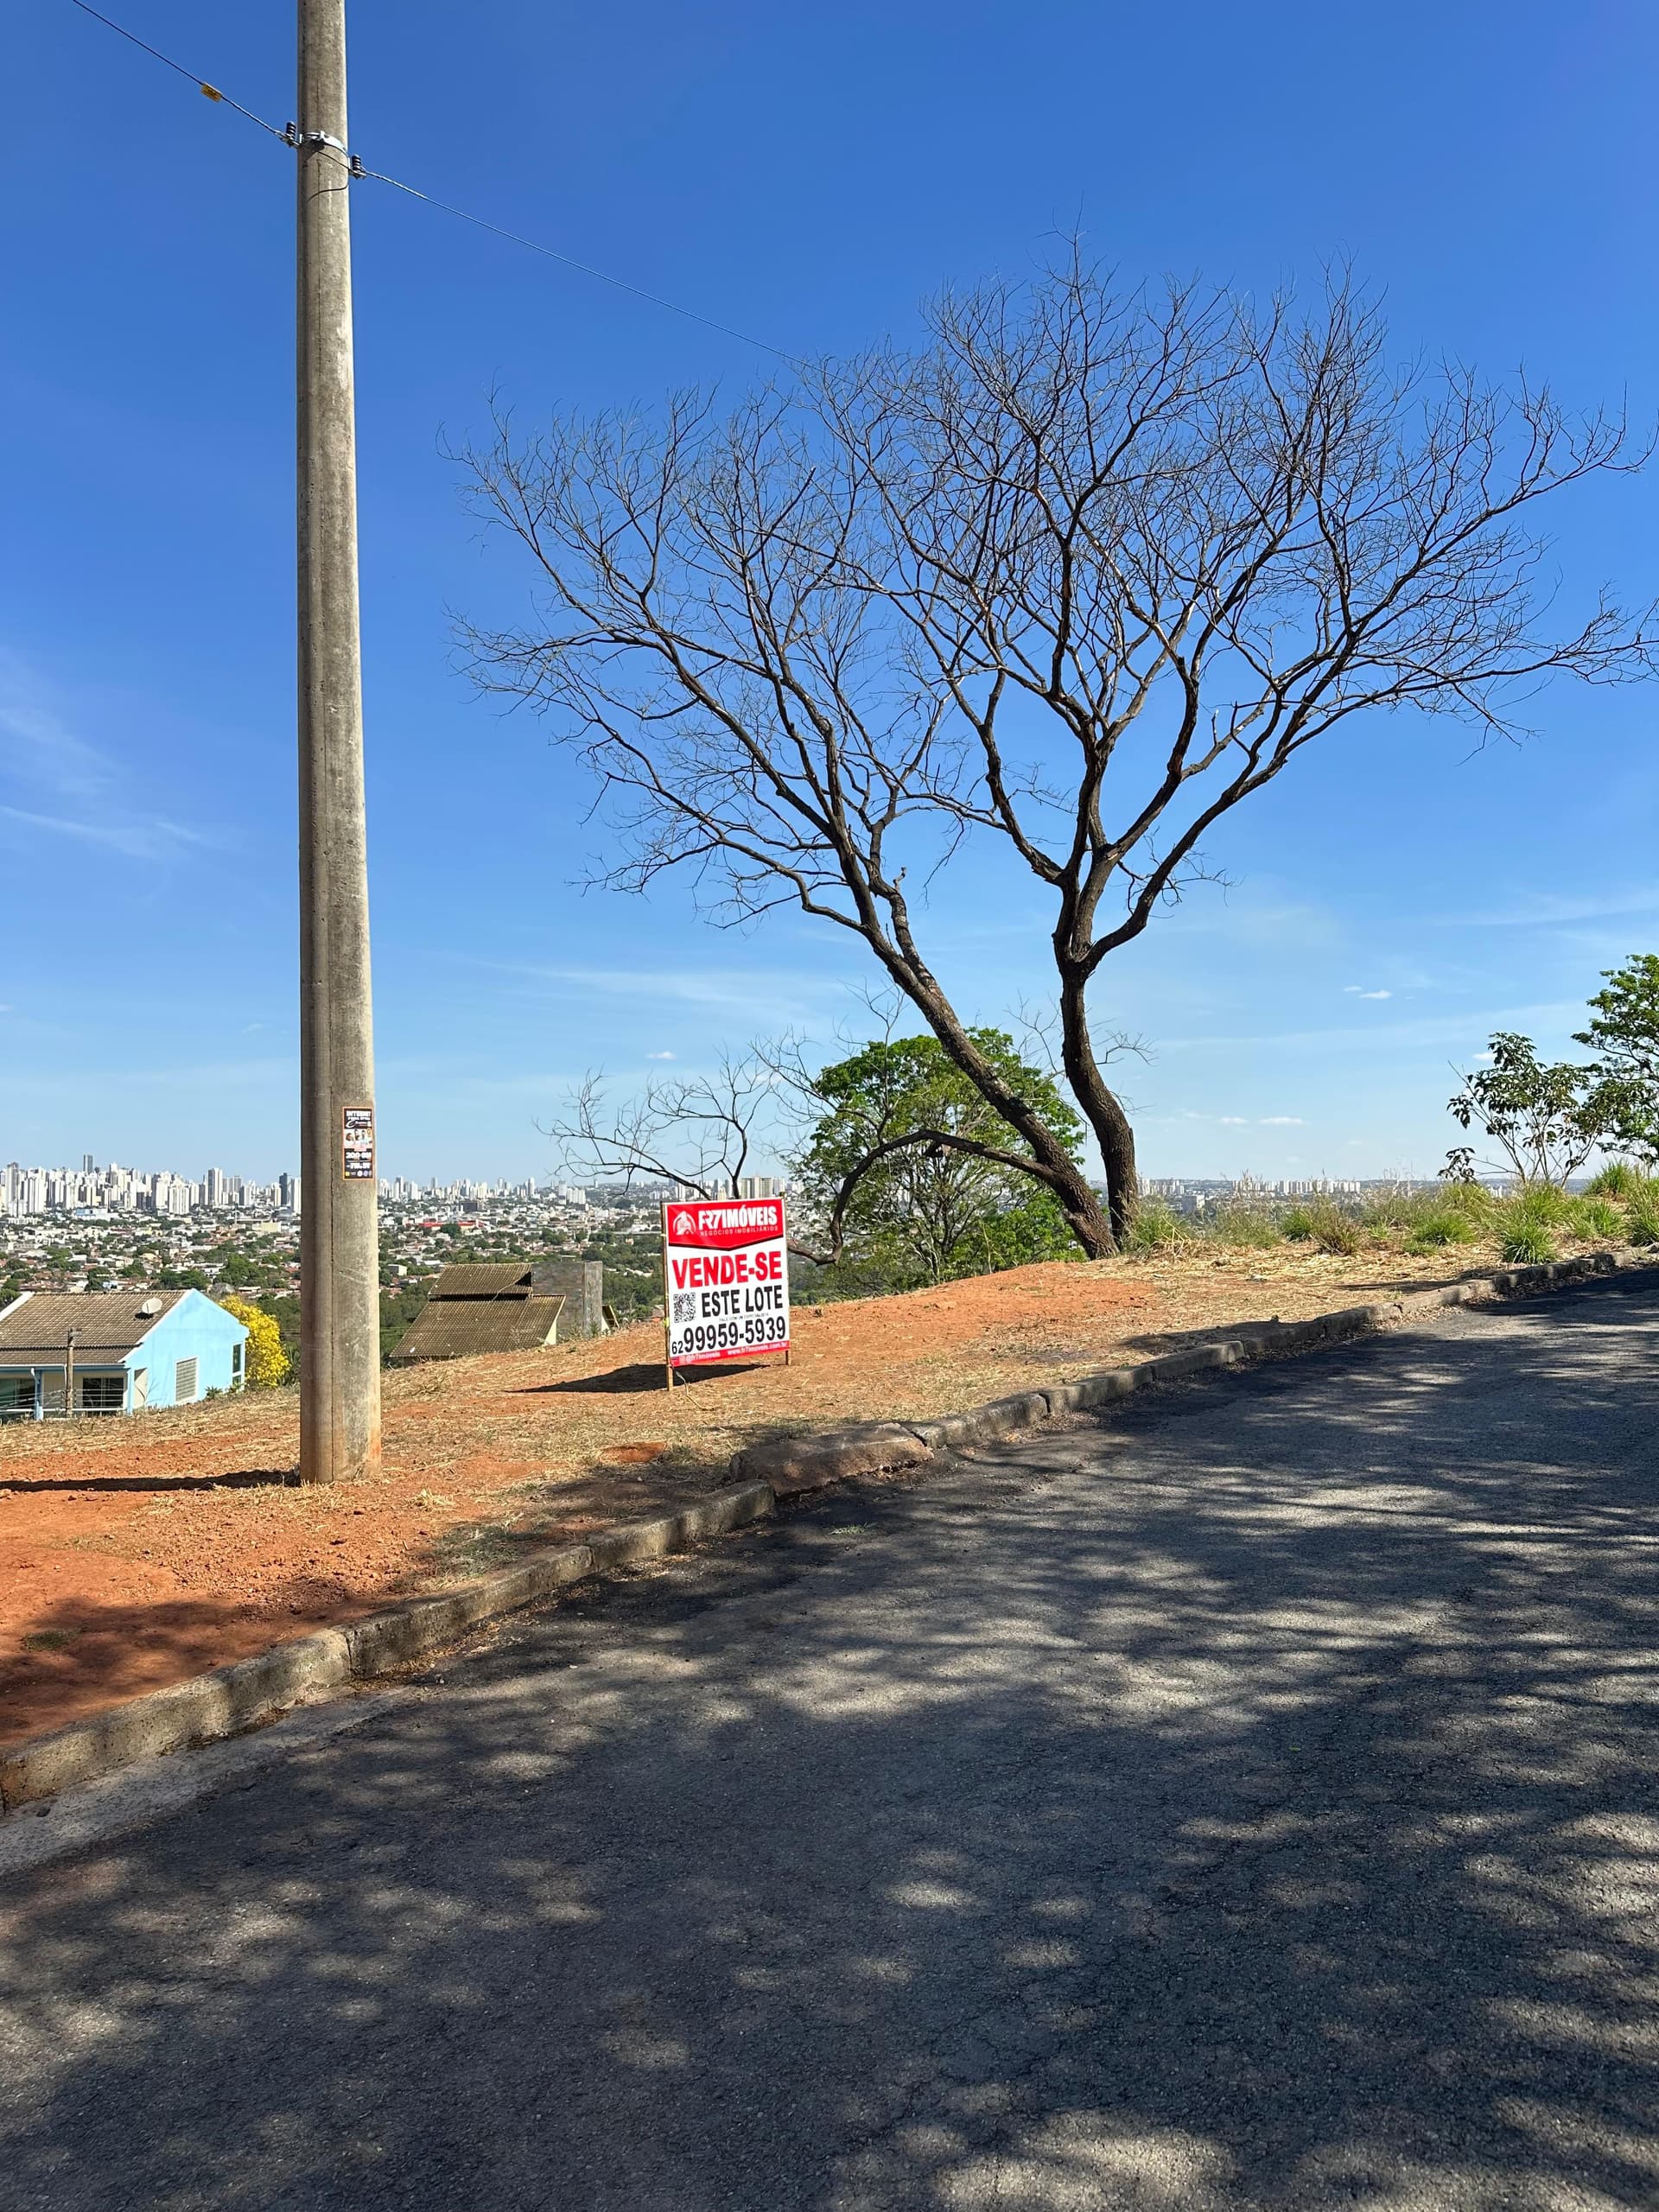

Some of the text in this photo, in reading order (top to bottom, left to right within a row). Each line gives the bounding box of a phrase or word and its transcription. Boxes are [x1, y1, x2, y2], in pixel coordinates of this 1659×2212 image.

[671, 1251, 783, 1289] VENDE-SE
[702, 1285, 783, 1318] ESTE LOTE
[671, 1316, 786, 1355] 62 99959-5939
